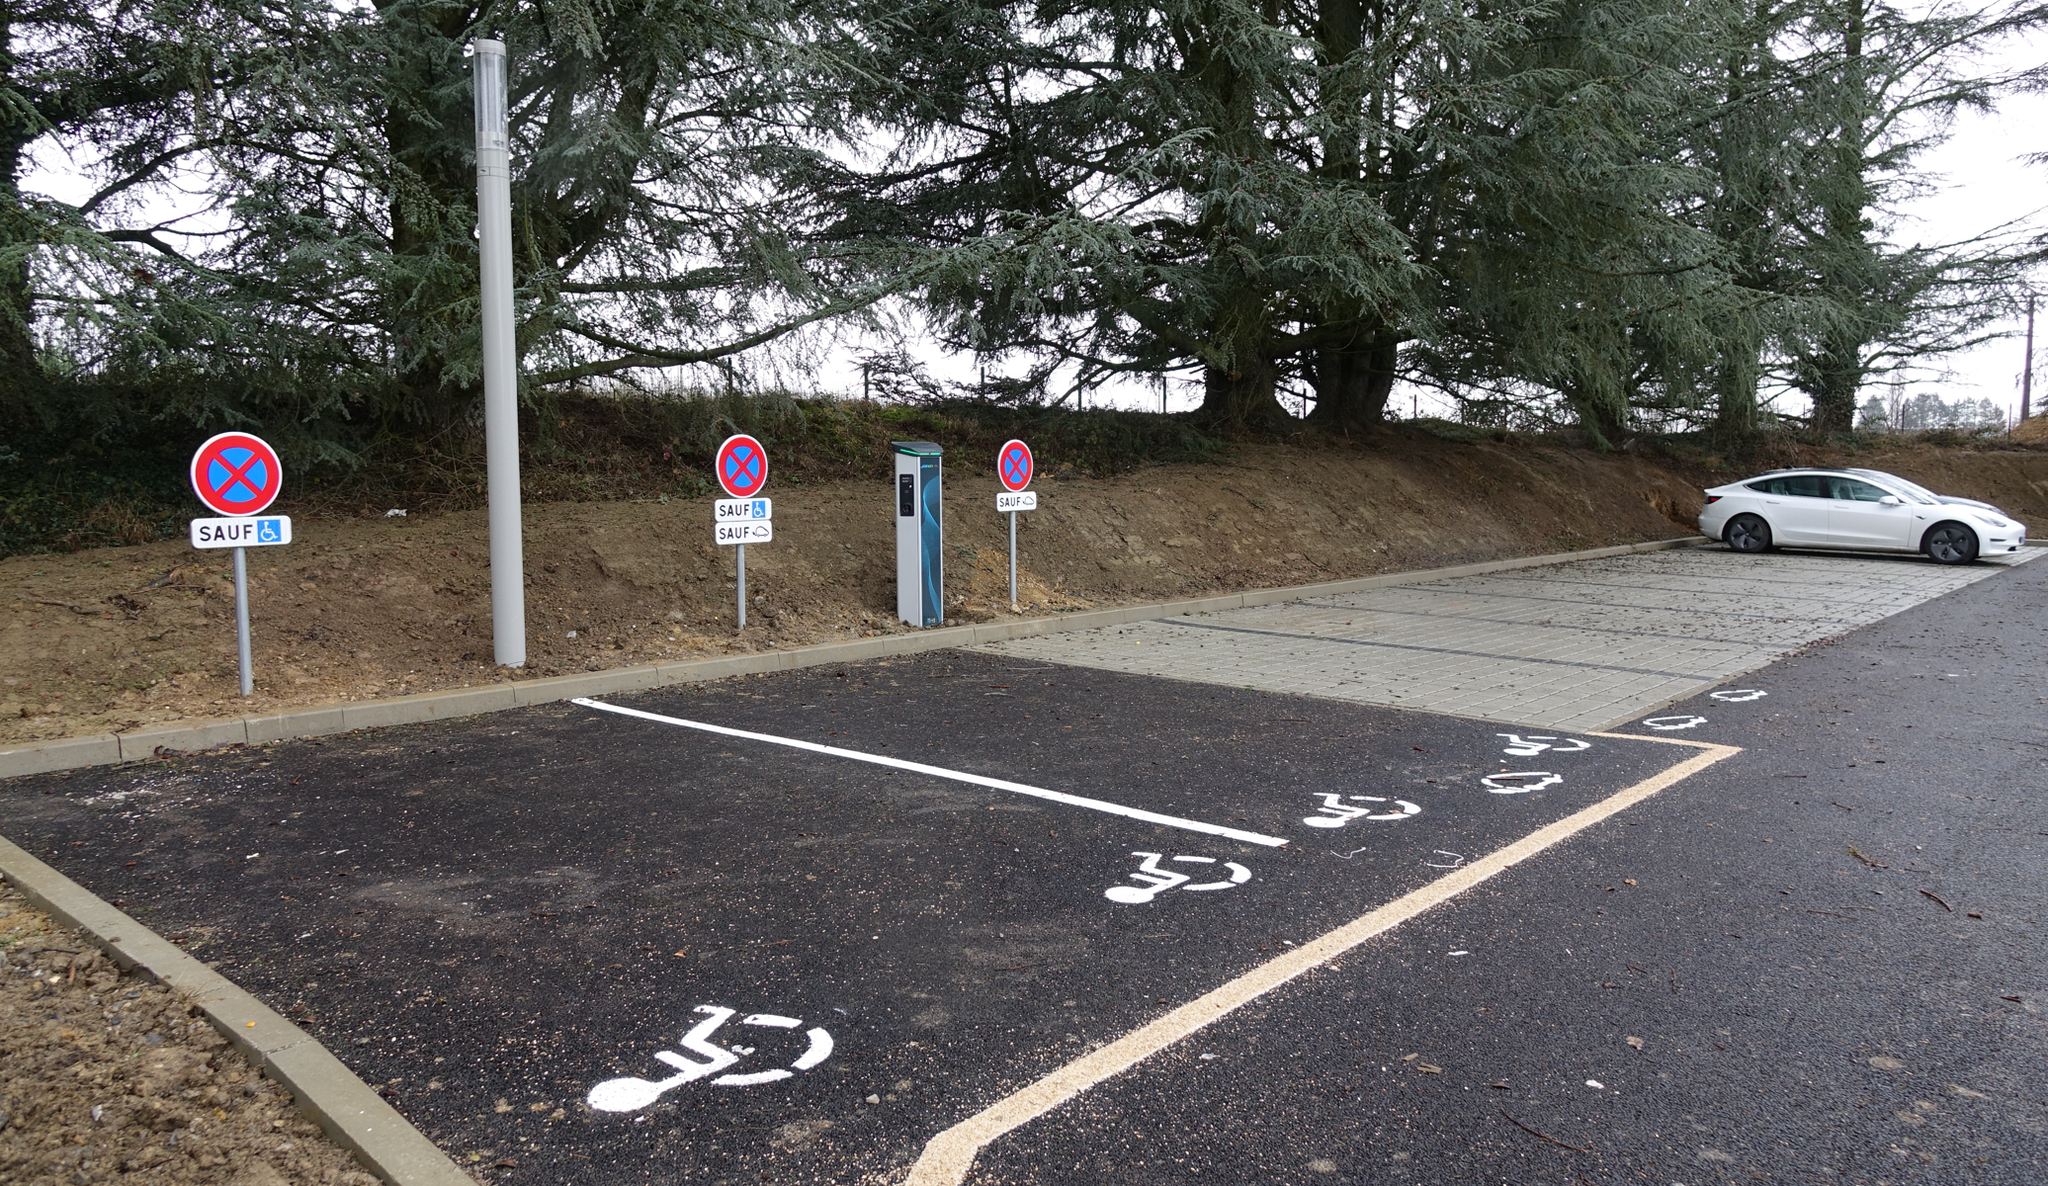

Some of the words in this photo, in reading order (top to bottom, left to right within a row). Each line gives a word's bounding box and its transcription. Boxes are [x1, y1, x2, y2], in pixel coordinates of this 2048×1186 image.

[999, 496, 1021, 508] SAUF
[719, 504, 750, 517] SAUF
[199, 524, 253, 542] SAUF
[719, 526, 750, 540] SAUF
